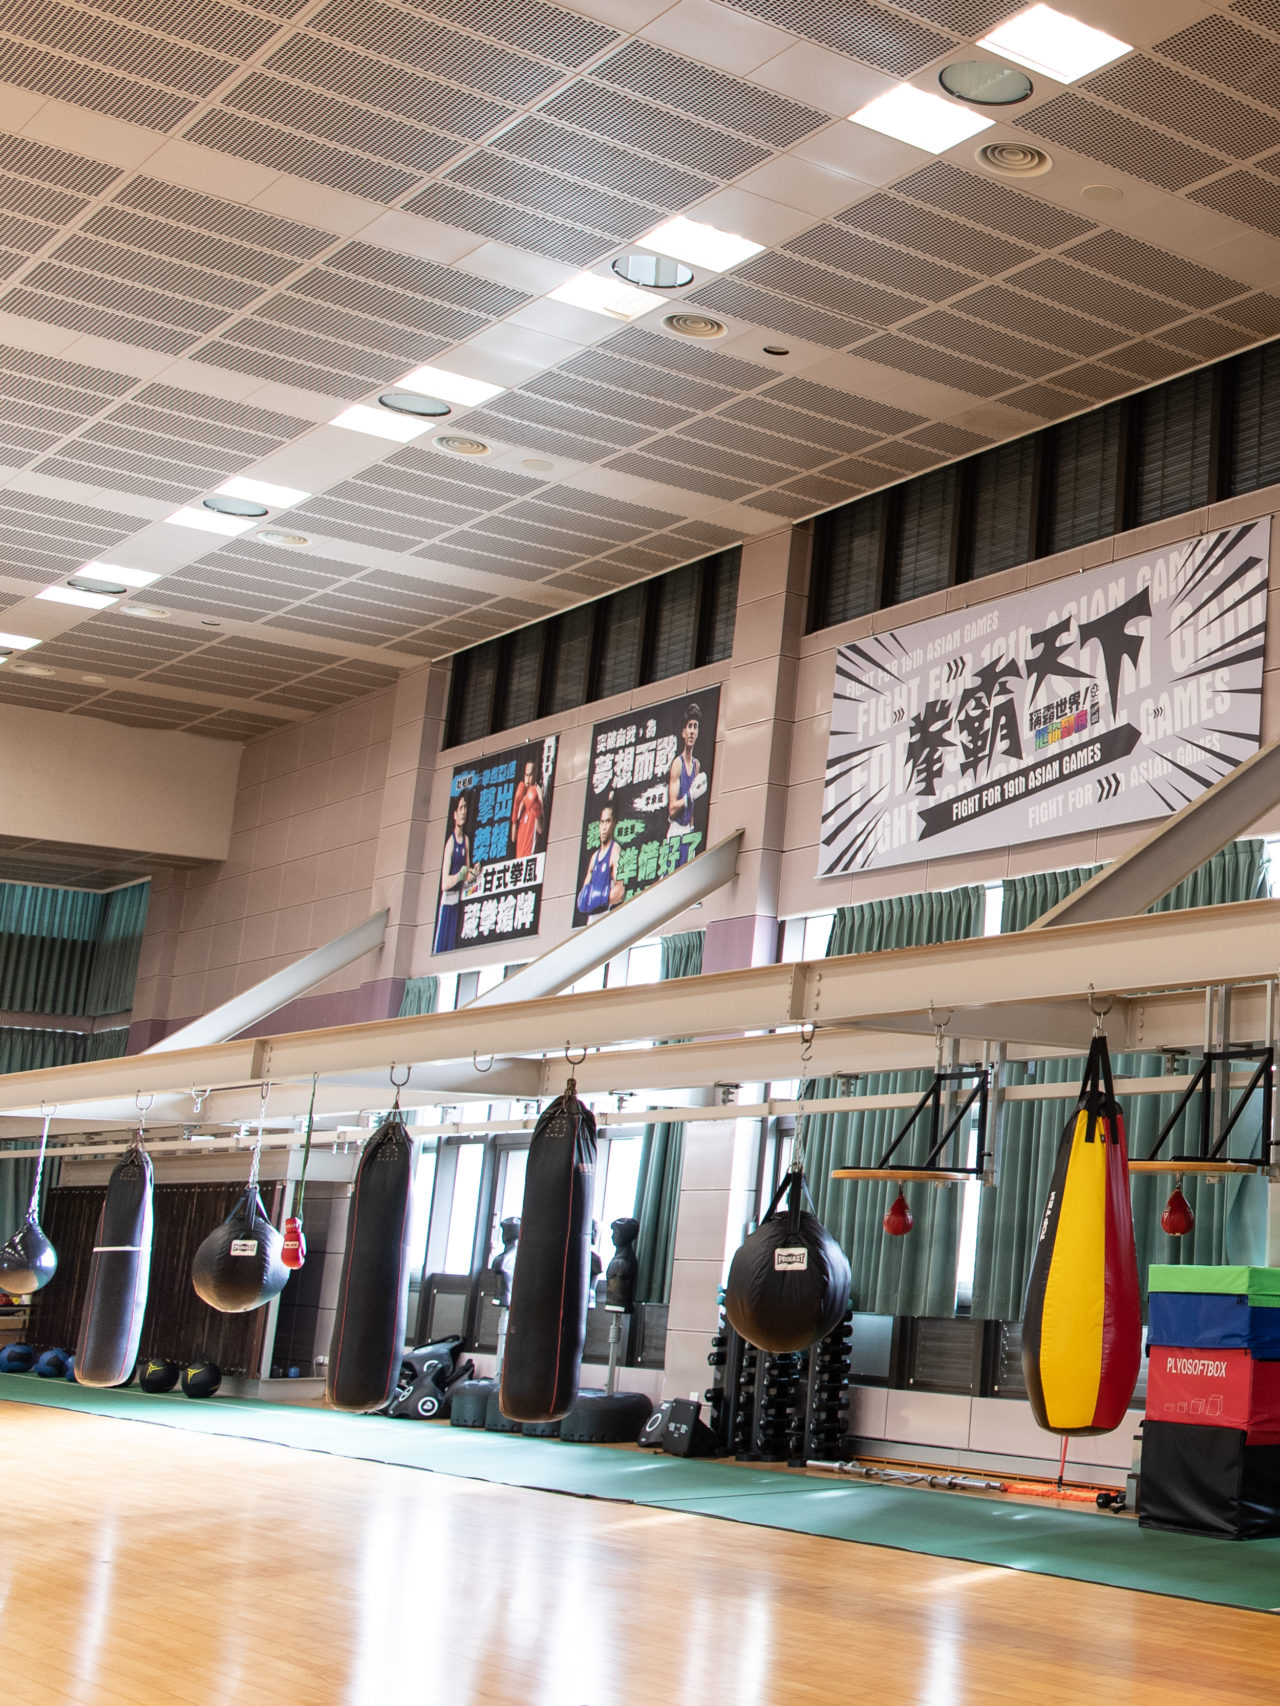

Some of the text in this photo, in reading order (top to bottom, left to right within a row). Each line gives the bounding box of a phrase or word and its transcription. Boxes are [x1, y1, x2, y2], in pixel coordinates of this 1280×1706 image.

[927, 628, 961, 662] ASIAN
[964, 610, 999, 643] GAMES
[952, 796, 980, 822] FIGHT
[981, 787, 1002, 809] FOR
[1003, 775, 1026, 800] 19th
[1028, 764, 1060, 789] ASIAN
[1062, 743, 1102, 776] GAMES
[1028, 794, 1065, 829] FIGHT
[1067, 784, 1093, 812] FOR
[1166, 1357, 1227, 1379] PLYOSOFTBOX
